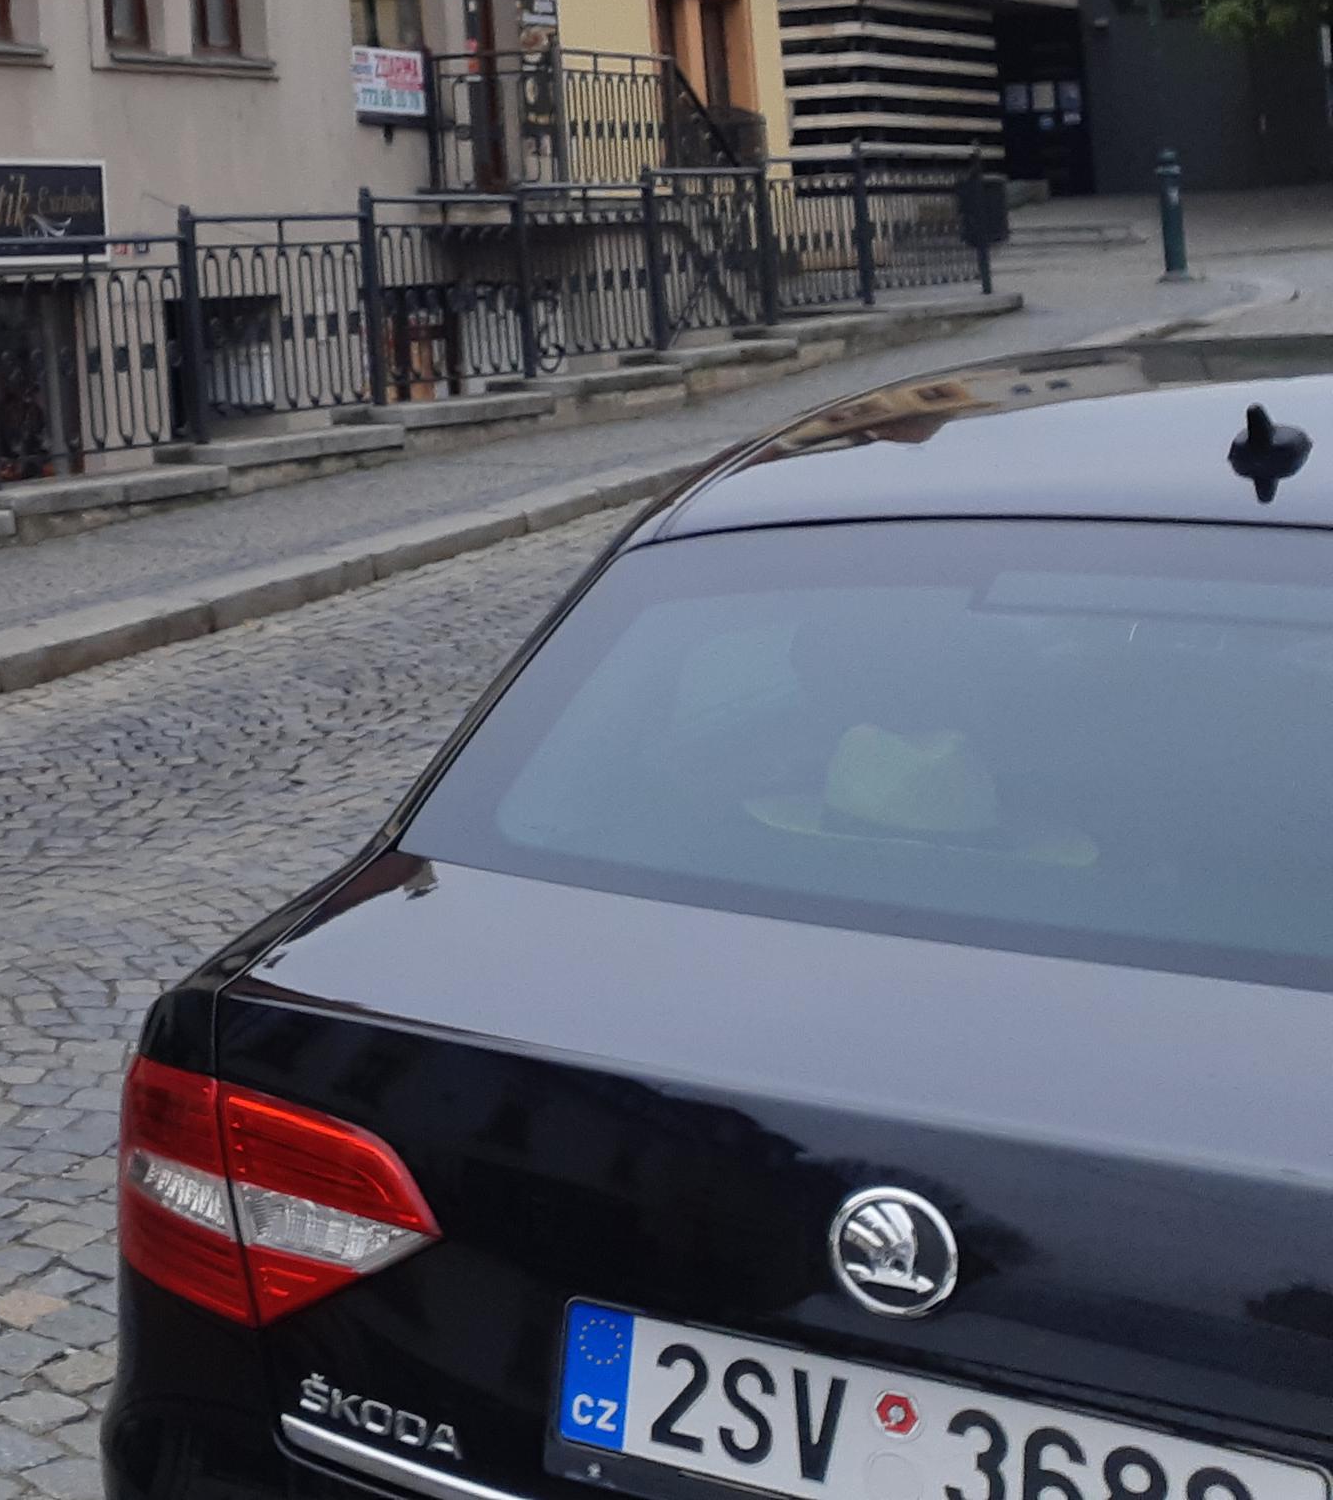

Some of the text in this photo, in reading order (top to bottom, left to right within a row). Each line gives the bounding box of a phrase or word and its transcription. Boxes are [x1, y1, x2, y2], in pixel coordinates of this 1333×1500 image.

[299, 1372, 463, 1461] ŠKODA
[571, 1393, 619, 1433] CZ
[649, 1342, 848, 1484] 2SV
